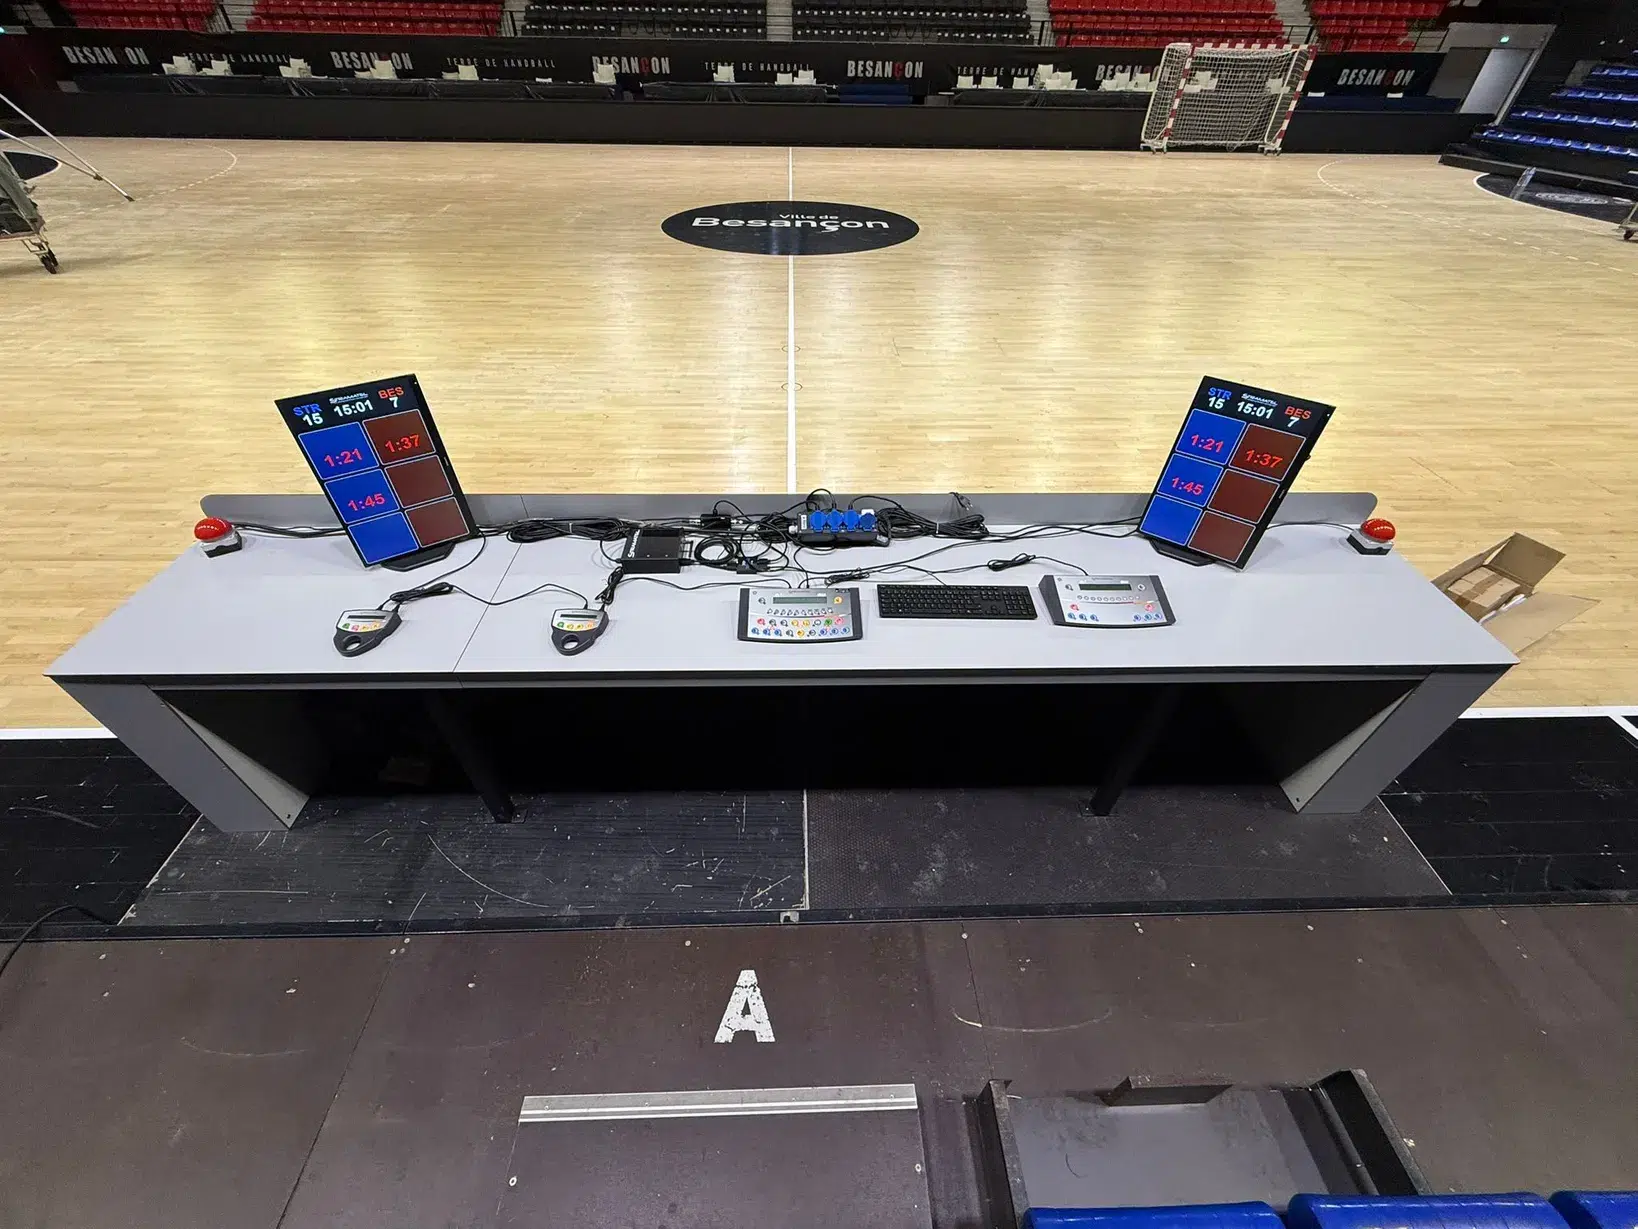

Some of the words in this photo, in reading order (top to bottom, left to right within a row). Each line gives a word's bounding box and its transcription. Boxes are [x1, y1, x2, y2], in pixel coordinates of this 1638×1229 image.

[846, 60, 924, 80] BESANÇON
[691, 216, 890, 232] Besançon
[293, 403, 322, 416] STR
[333, 399, 373, 417] 15:01
[378, 386, 405, 399] BES
[302, 412, 324, 426] 15
[388, 396, 398, 408] 7
[1207, 387, 1232, 400] STR
[1237, 401, 1274, 419] 15:01
[1284, 406, 1312, 419] BES
[1208, 397, 1226, 409] 15
[1287, 416, 1300, 428] 7
[324, 448, 363, 467] 1:21
[384, 434, 420, 453] 1:37
[1190, 434, 1224, 453] 1:21
[1244, 450, 1283, 468] 1:37
[347, 493, 385, 511] 1:45
[1172, 477, 1204, 496] 1:45
[713, 969, 776, 1043] A
